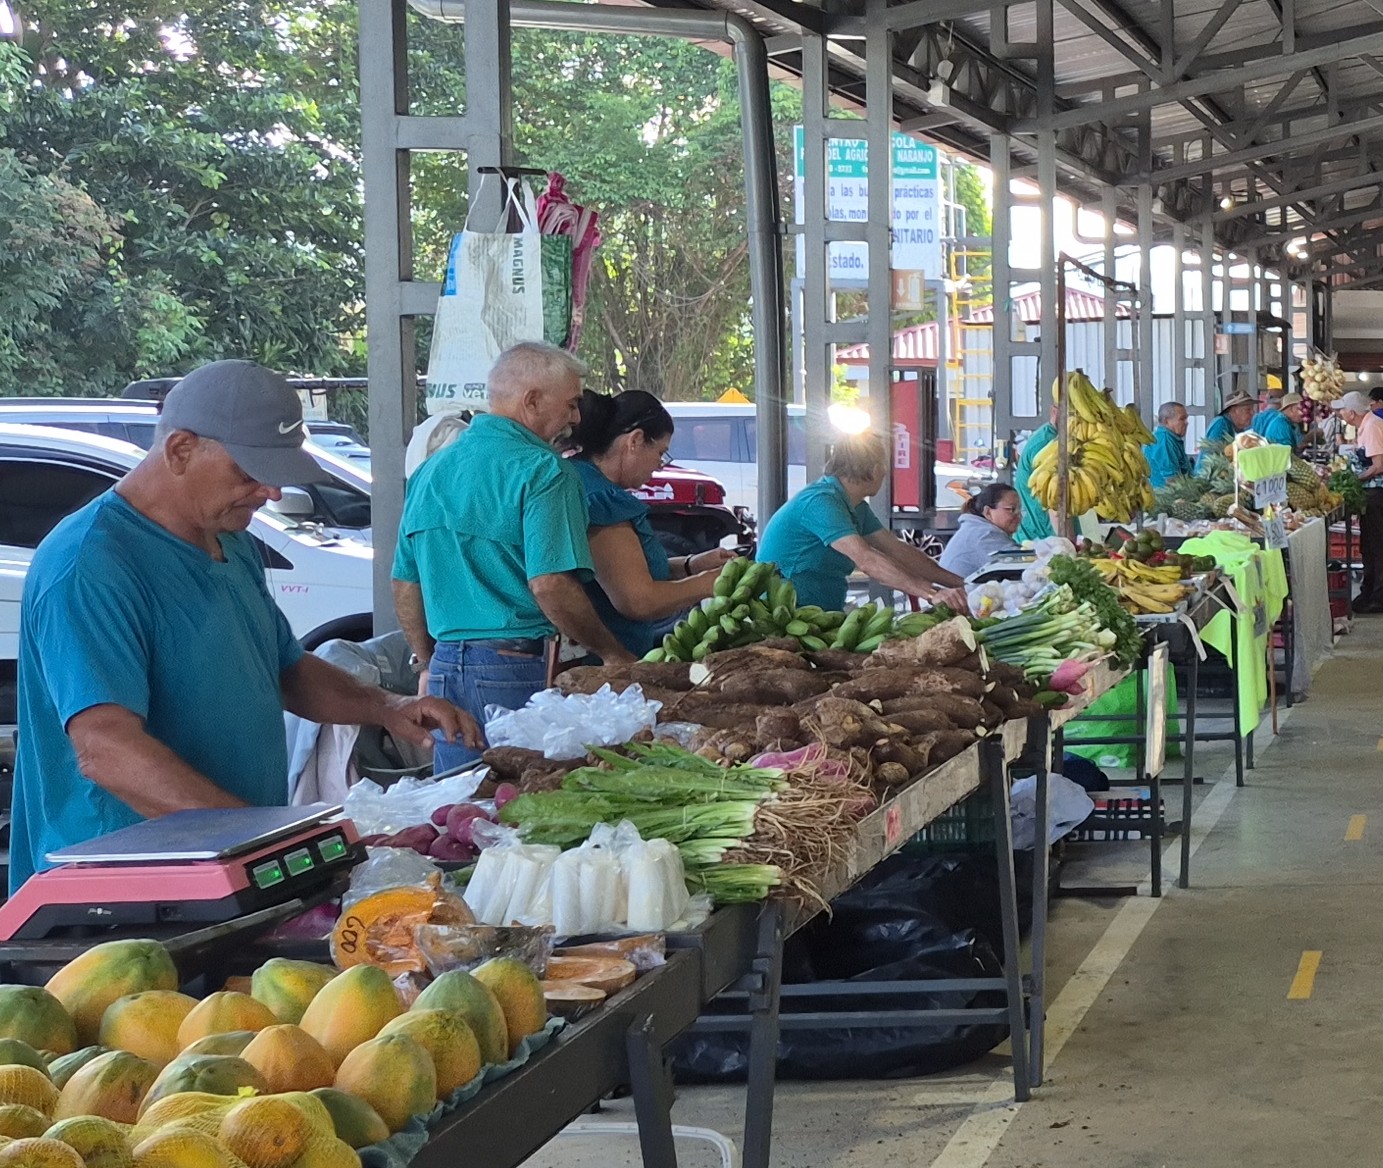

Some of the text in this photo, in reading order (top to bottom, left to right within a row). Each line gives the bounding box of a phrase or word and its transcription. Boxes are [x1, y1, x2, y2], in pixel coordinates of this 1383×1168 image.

[896, 150, 933, 162] NARANJO
[841, 185, 853, 196] las
[894, 185, 934, 199] prácticas
[905, 209, 919, 221] por
[925, 207, 932, 219] el
[892, 228, 933, 244] NITARIO
[512, 237, 525, 294] MAGNUS
[832, 252, 864, 269] stado.
[427, 382, 457, 399] NUS
[341, 916, 366, 953] 600
